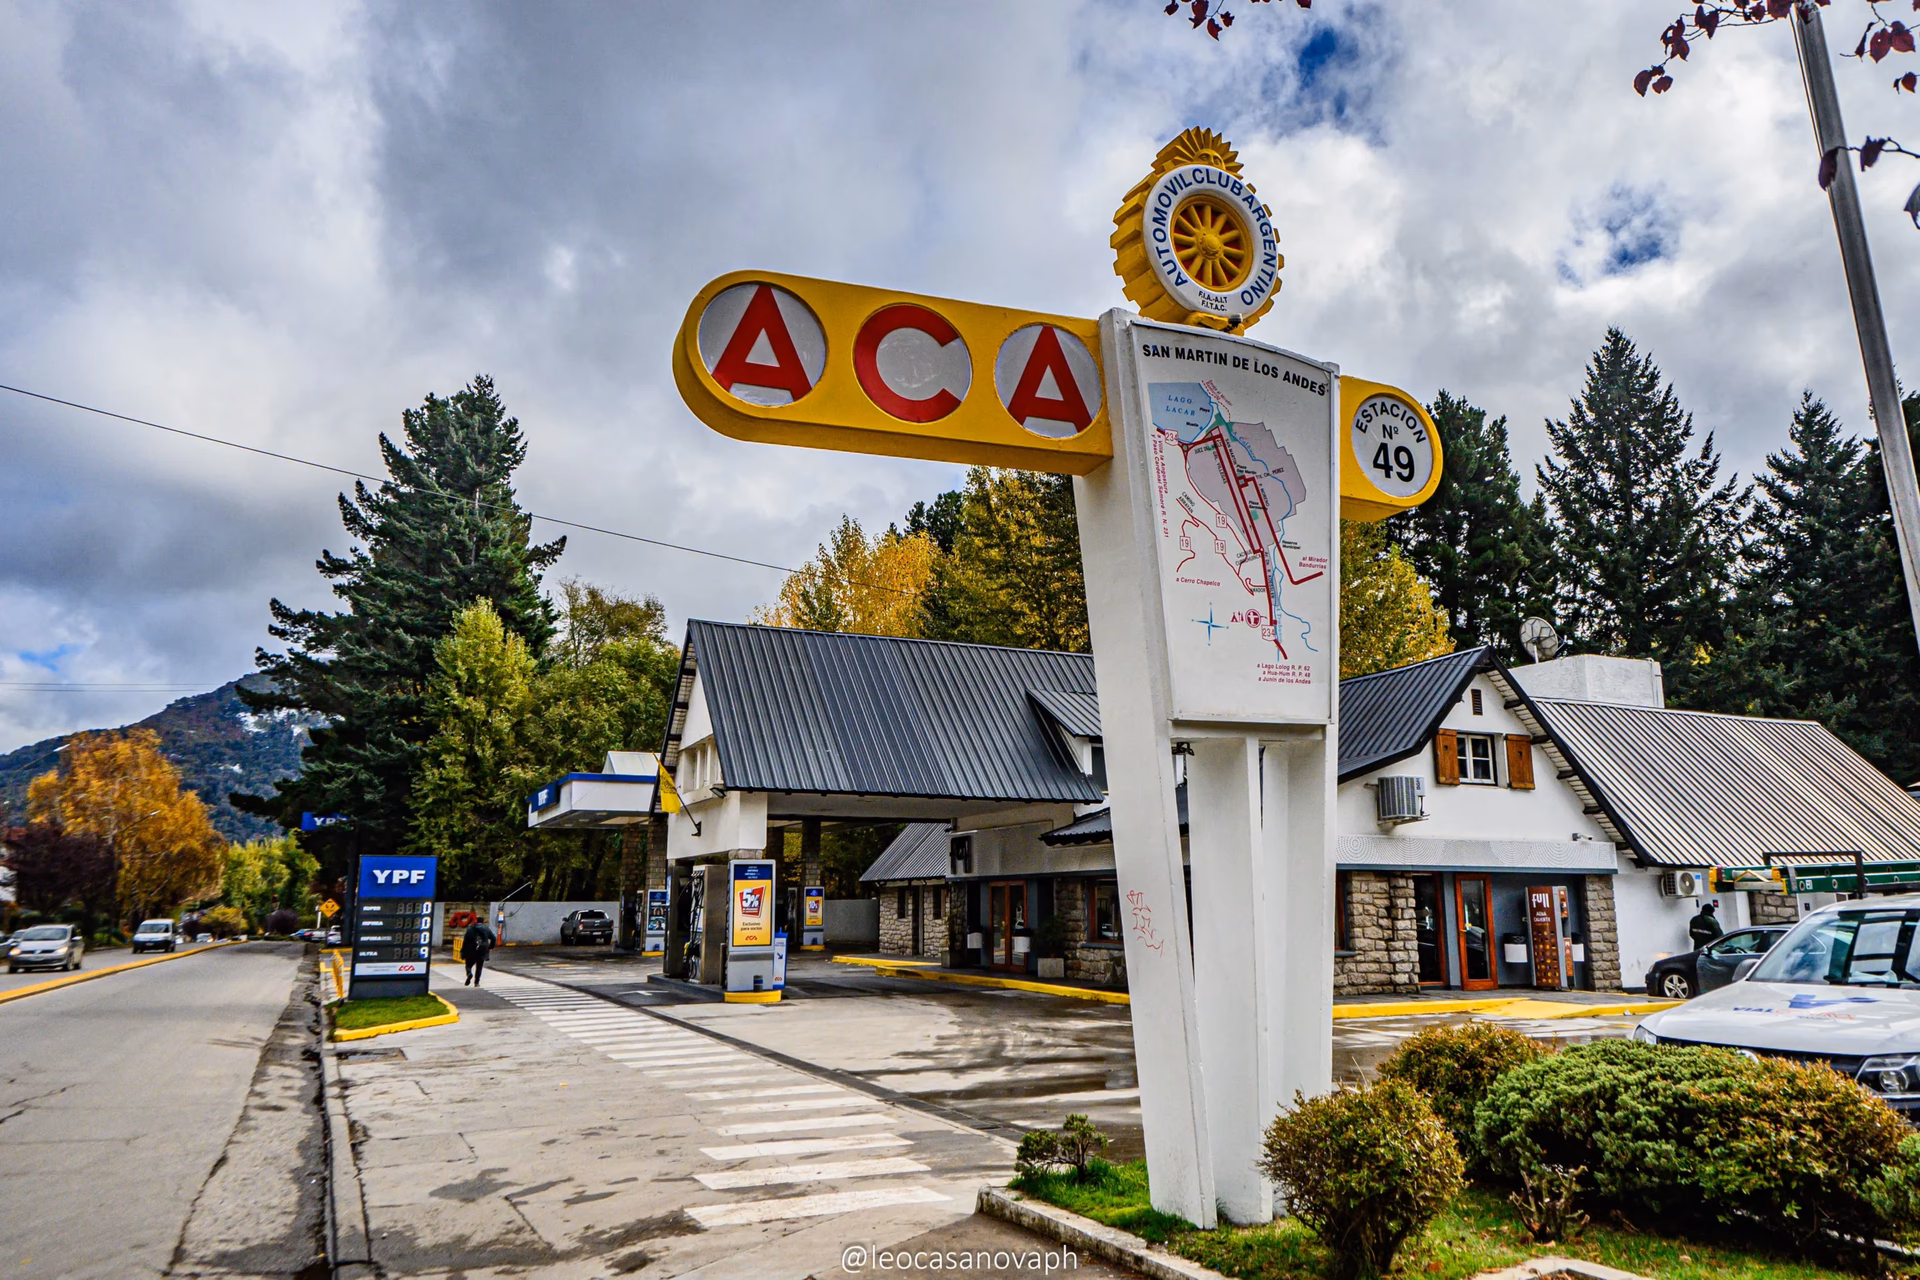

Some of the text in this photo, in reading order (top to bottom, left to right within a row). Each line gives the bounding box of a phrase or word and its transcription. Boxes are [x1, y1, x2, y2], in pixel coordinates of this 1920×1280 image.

[1152, 168, 1277, 306] AUTOMOVIL CLUB ARGENTINO
[711, 284, 1094, 434] ACA
[1142, 344, 1326, 397] SAN MARTIN DE LOS ANDES
[1168, 395, 1193, 404] LAGO
[1166, 405, 1196, 416] LACAR
[1355, 401, 1427, 444] ESTACION
[1154, 456, 1162, 485] Cardenal
[1373, 442, 1415, 483] 49
[1160, 462, 1169, 494] Angostura
[1217, 516, 1226, 525] 19
[1181, 539, 1189, 548] 19
[1216, 542, 1225, 551] 19
[1299, 561, 1327, 569] Bandurrias
[1196, 578, 1221, 587] Chapelco
[372, 869, 426, 884] YPF
[742, 888, 760, 908] 5%
